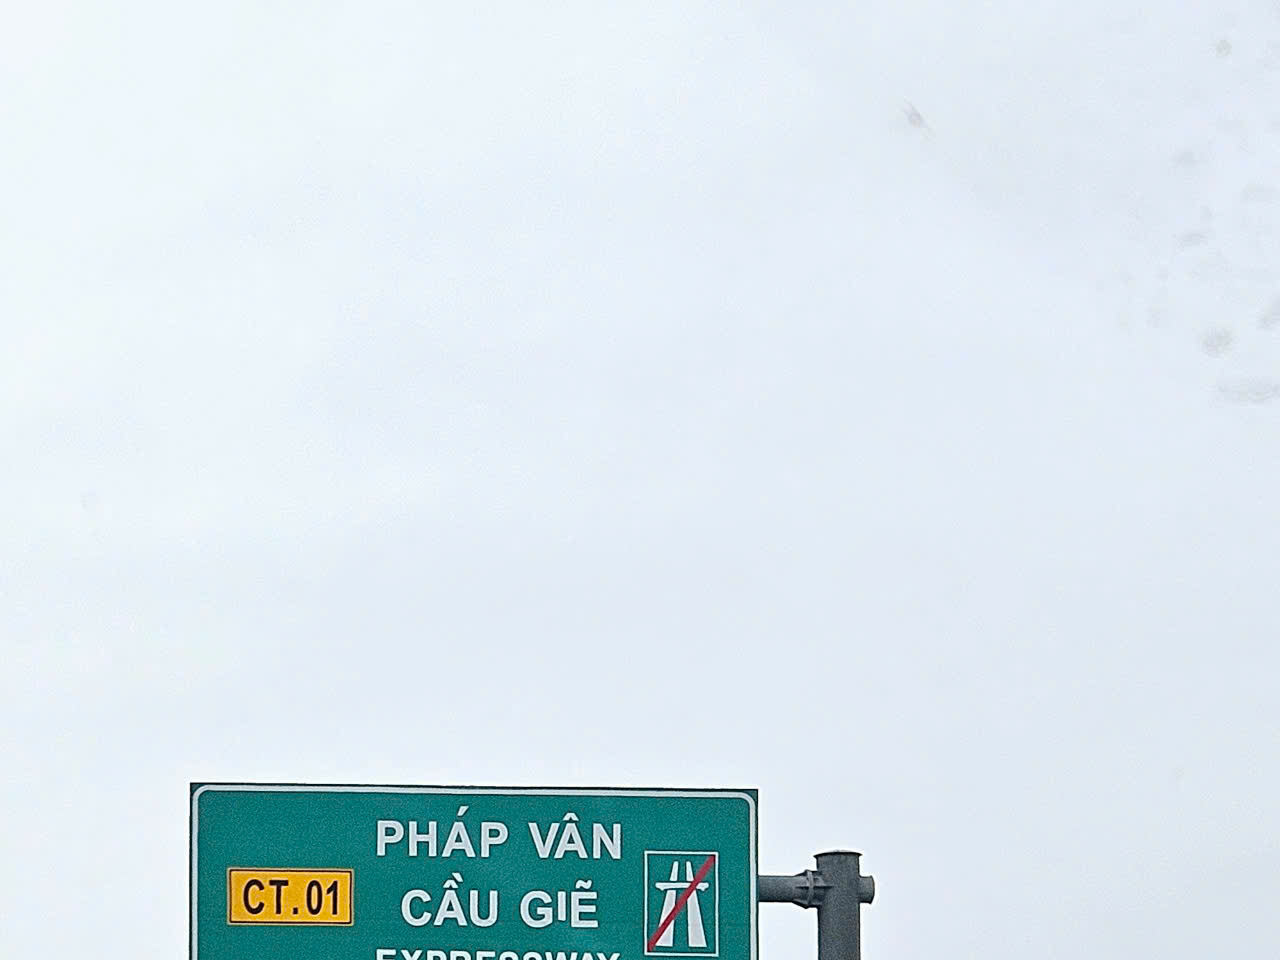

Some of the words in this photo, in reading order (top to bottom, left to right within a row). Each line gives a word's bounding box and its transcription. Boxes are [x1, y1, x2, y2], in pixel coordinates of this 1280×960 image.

[376, 805, 509, 860] PHÁP
[528, 812, 622, 860] VÂN
[242, 878, 340, 916] CT.01
[401, 871, 500, 928] CẦU
[520, 880, 600, 929] GIẼ
